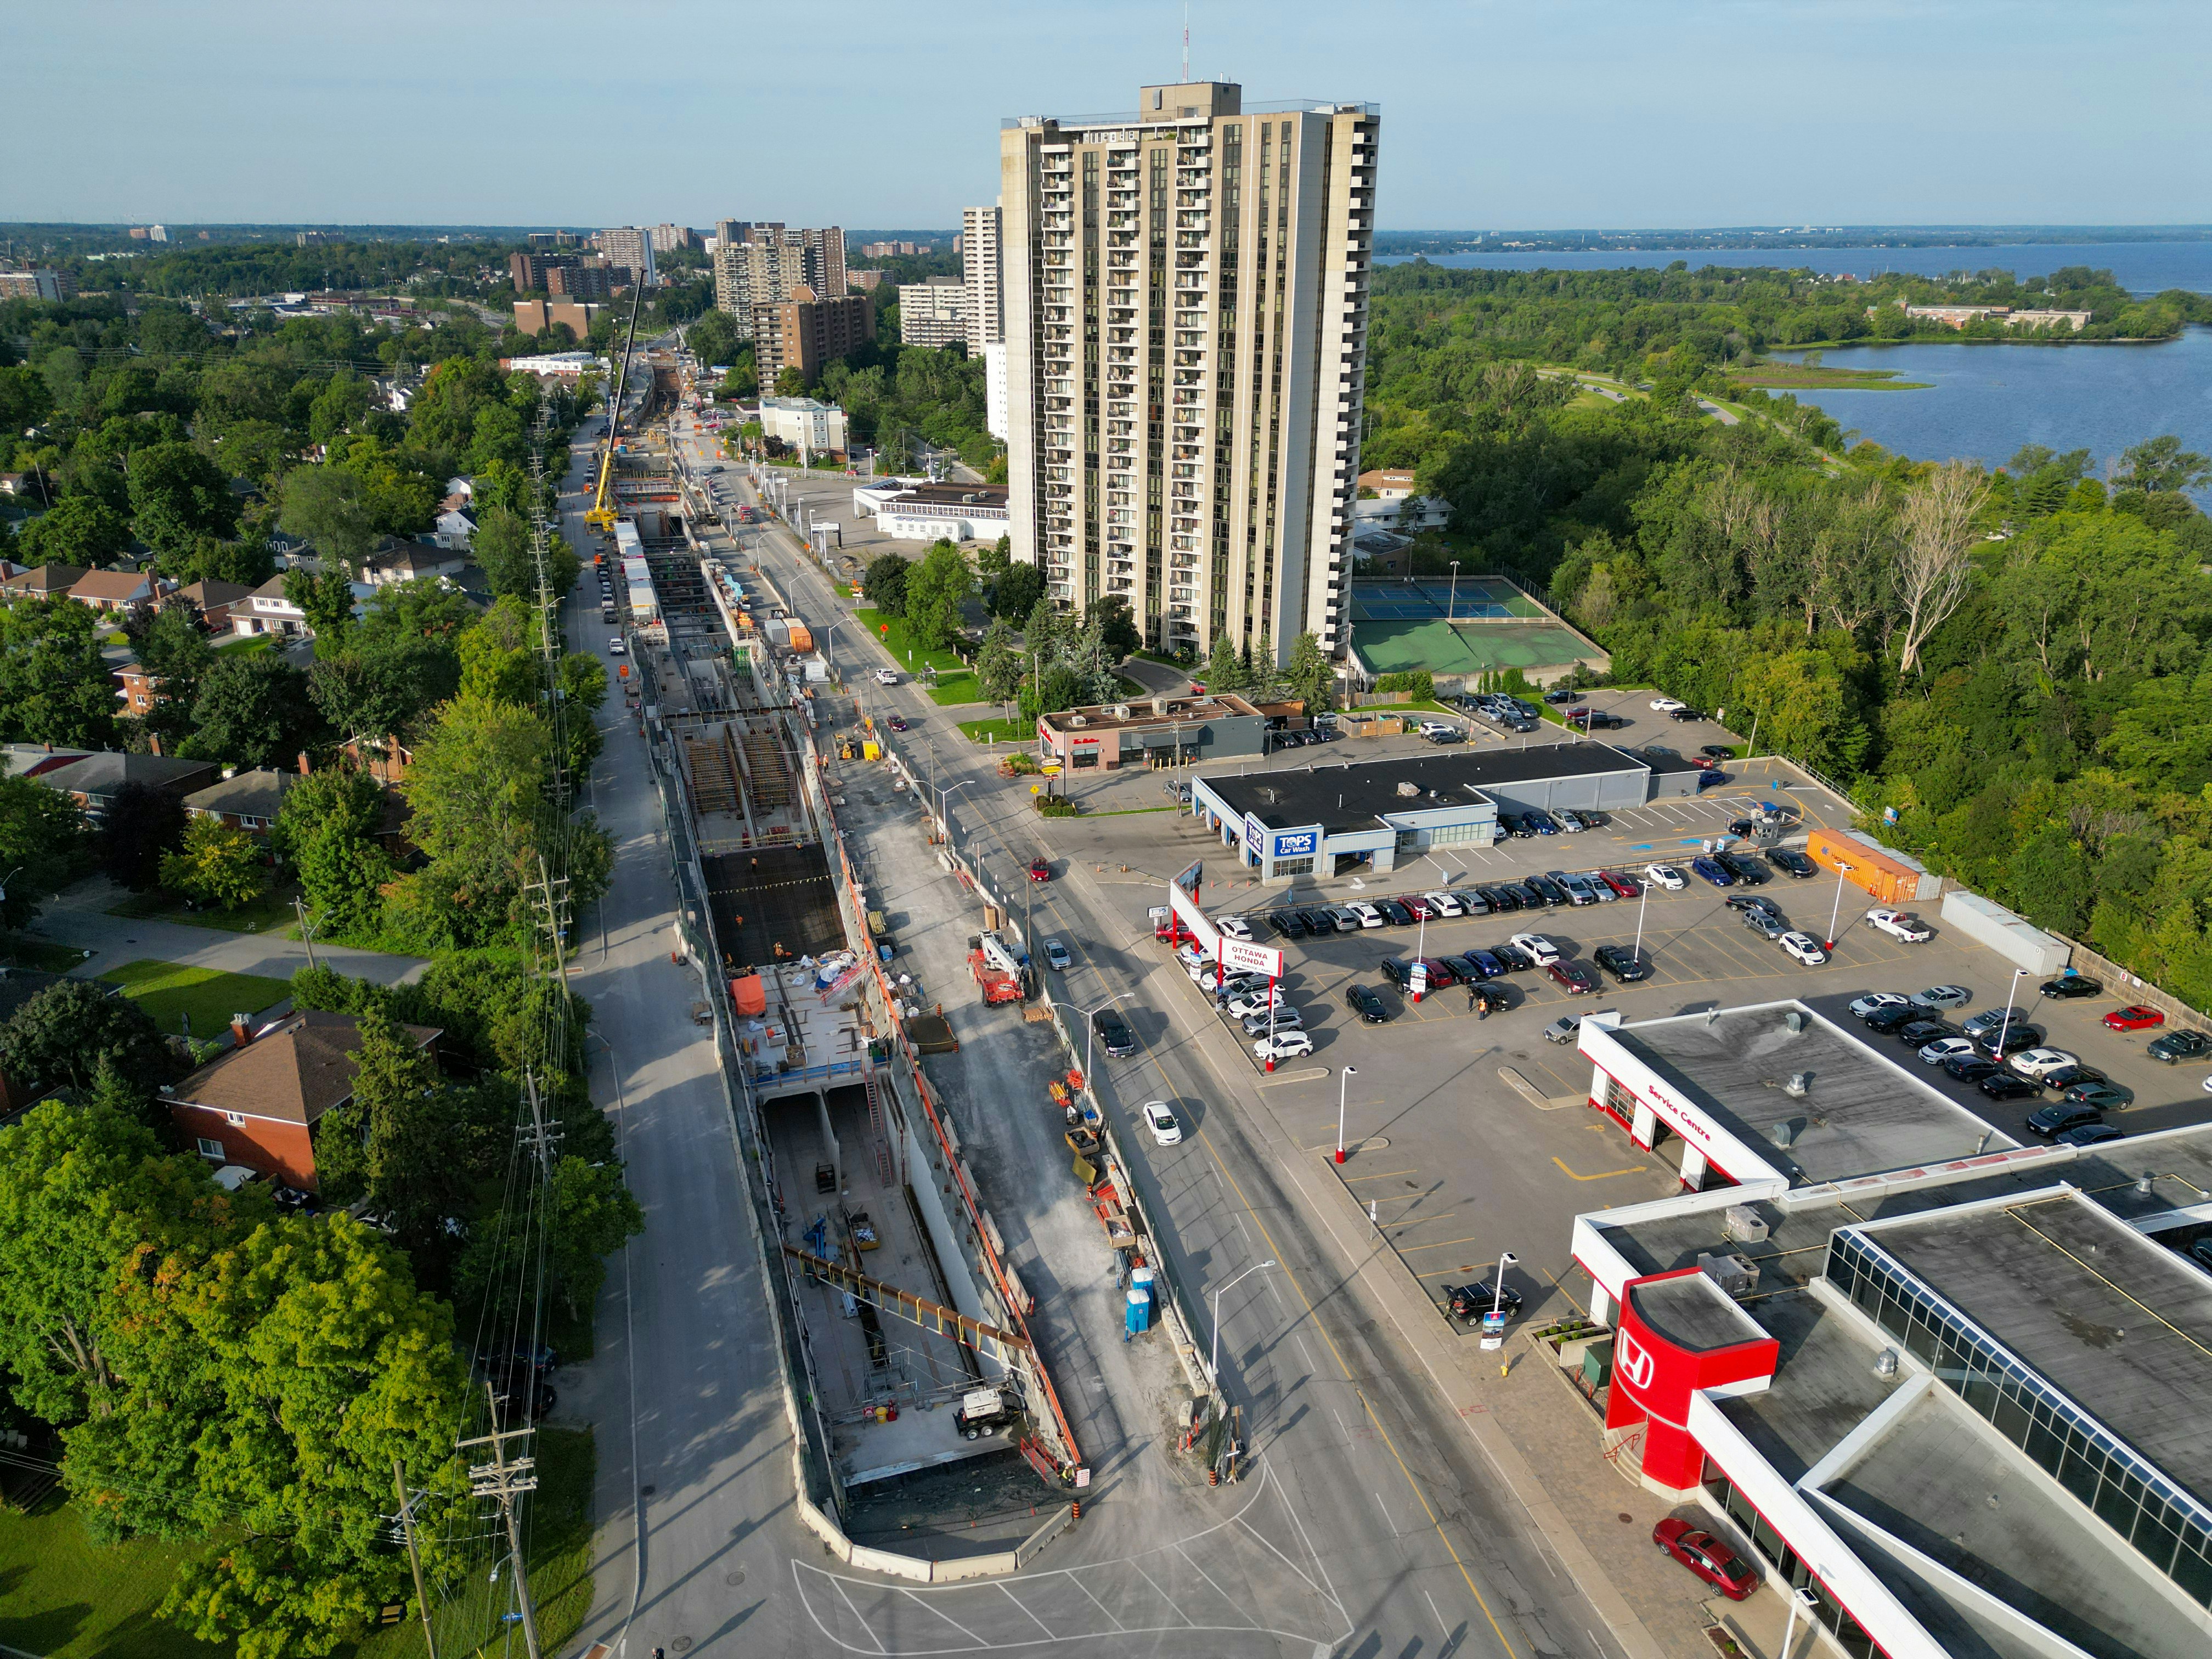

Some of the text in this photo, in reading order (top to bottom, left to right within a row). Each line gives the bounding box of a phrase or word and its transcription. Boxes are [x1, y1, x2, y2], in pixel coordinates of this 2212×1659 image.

[1248, 823, 1262, 844] TOPS
[1279, 834, 1311, 848] TOPS
[1232, 946, 1268, 960] OTTAWA
[1234, 955, 1265, 966] HONDA
[1649, 1085, 1711, 1141] Service Centre
